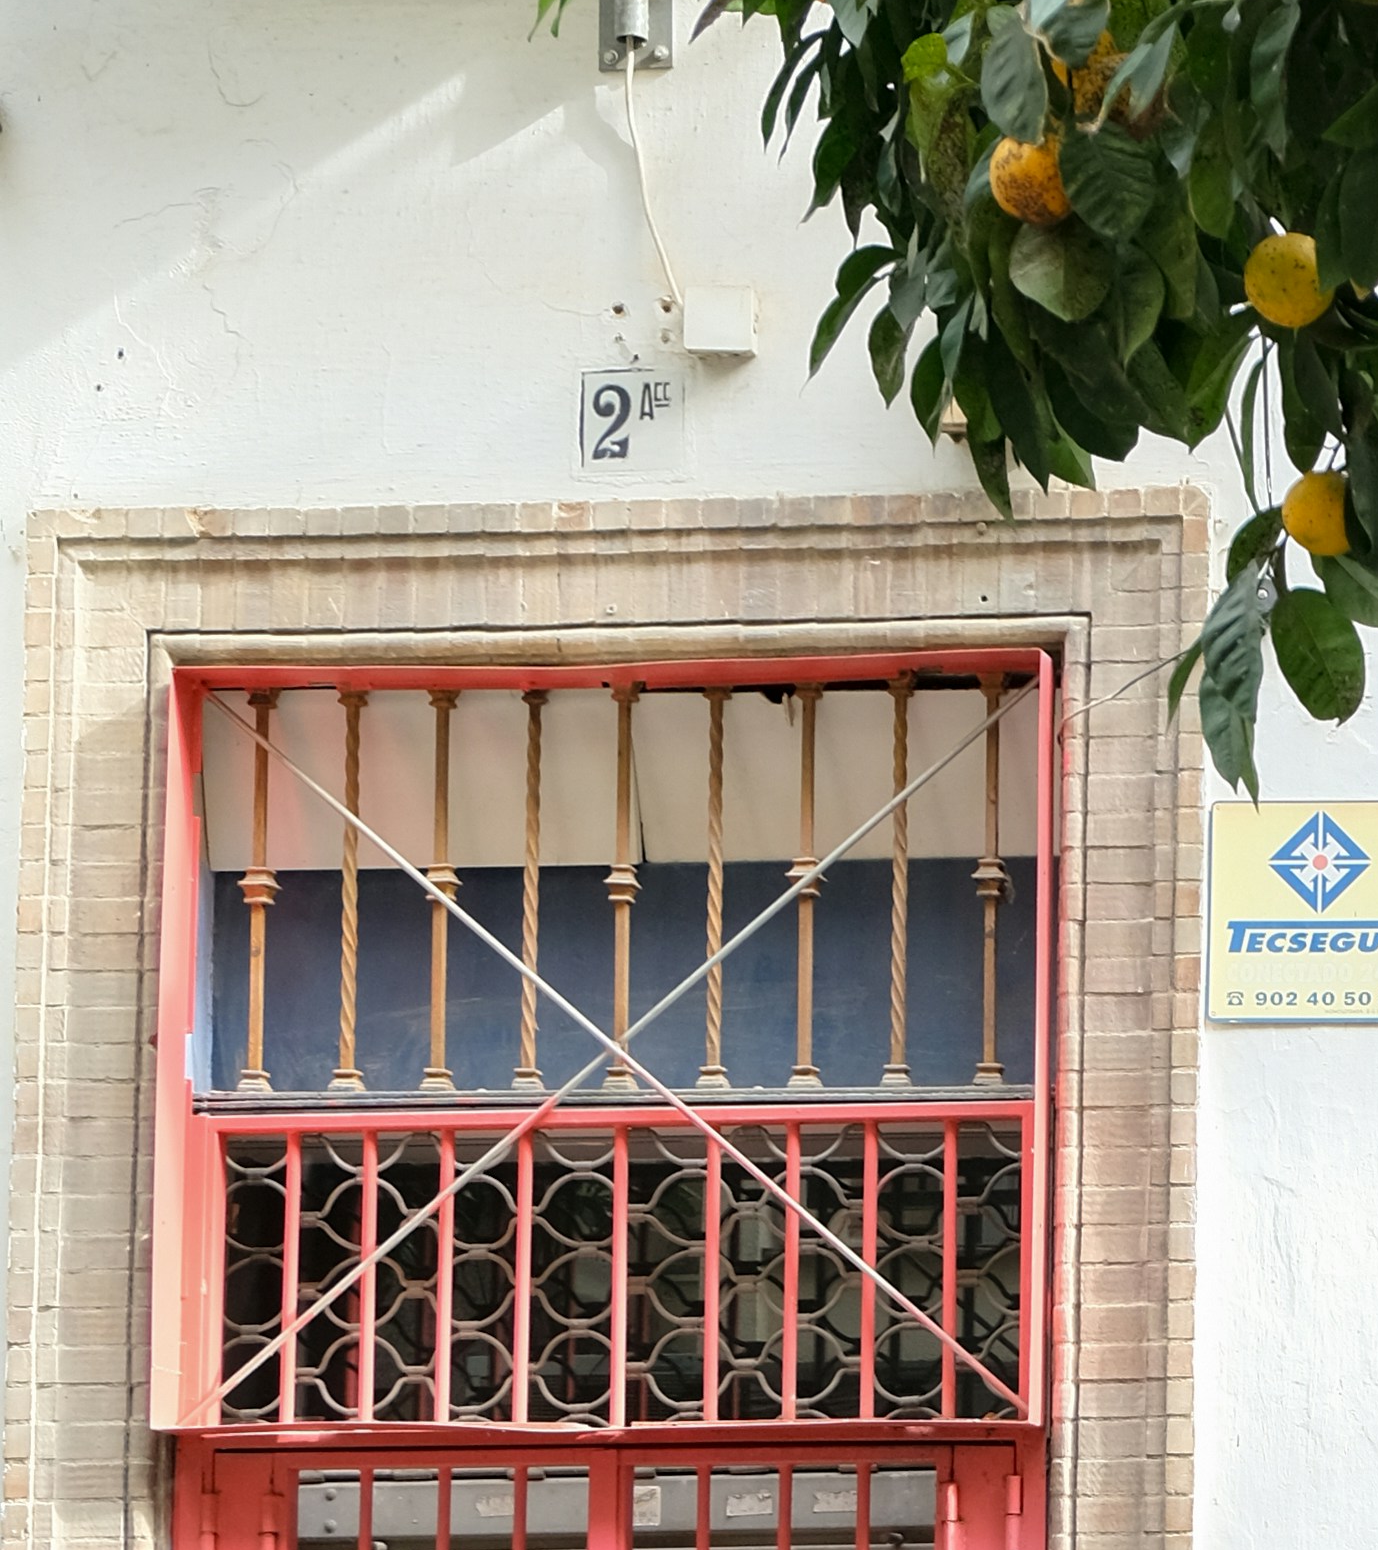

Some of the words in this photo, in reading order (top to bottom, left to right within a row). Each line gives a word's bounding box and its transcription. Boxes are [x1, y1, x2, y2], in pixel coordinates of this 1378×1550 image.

[592, 383, 631, 460] 2
[1255, 991, 1298, 1006] 902
[1306, 991, 1335, 1006] 40
[1344, 991, 1372, 1006] 50
